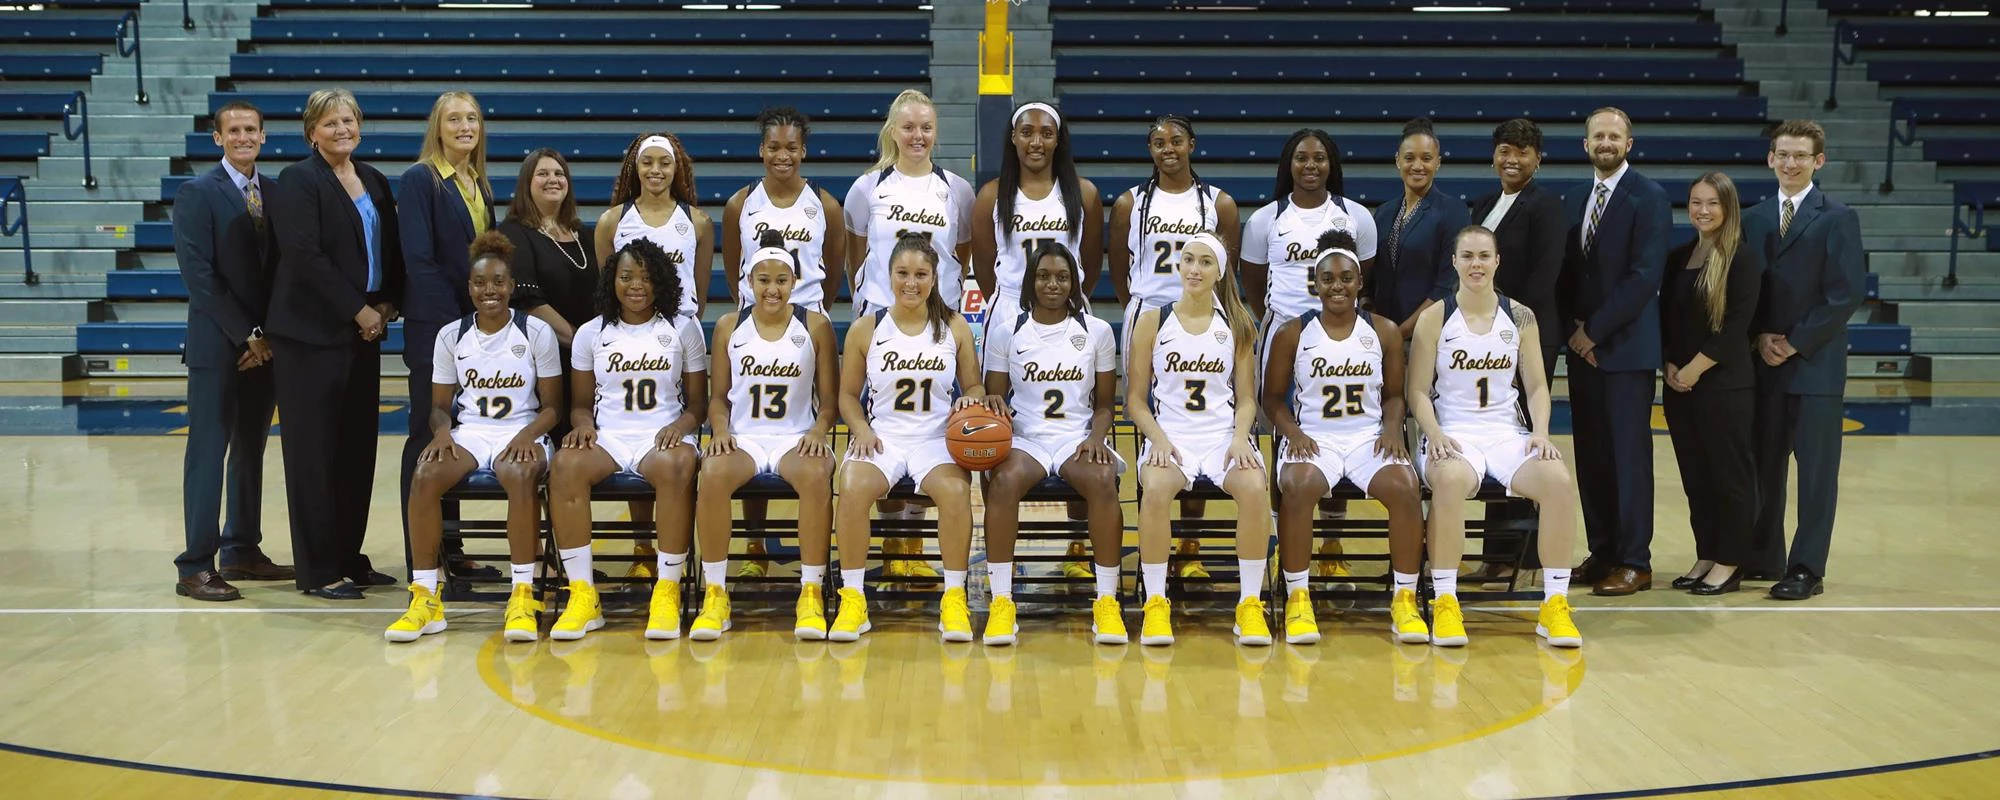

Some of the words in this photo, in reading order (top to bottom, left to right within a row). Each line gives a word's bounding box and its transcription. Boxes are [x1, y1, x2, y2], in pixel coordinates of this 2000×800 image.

[886, 204, 947, 227] Rockets
[1011, 214, 1070, 233] Rockets
[752, 222, 812, 243] Rkets
[606, 352, 671, 373] Rockets
[739, 355, 801, 378] Rockets
[880, 351, 946, 372] Rockets
[1164, 351, 1225, 373] Rockets
[1310, 357, 1374, 378] Rockets
[1449, 349, 1513, 371] Rockets
[464, 368, 526, 390] Rockets
[1022, 361, 1084, 383] Rockets
[622, 378, 657, 411] 10
[749, 384, 789, 420] 13
[894, 378, 933, 412] 21
[1043, 388, 1065, 419] 2
[1184, 379, 1207, 412] 3
[1321, 384, 1365, 419] 25
[1476, 377, 1489, 409] 1
[476, 396, 512, 420] 12
